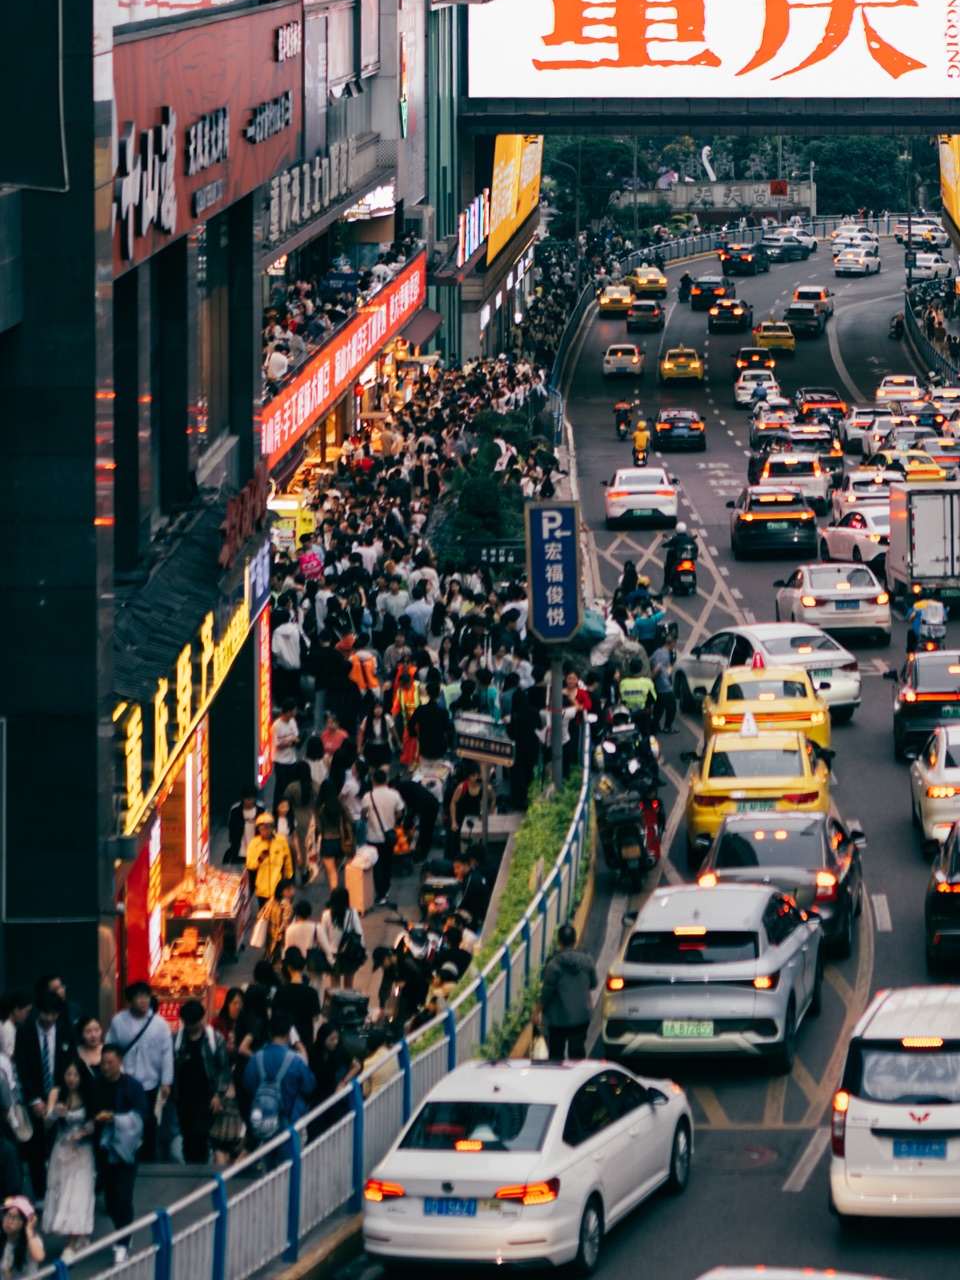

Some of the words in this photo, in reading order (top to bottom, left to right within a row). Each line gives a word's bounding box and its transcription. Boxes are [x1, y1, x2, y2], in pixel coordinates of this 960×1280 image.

[541, 510, 563, 540] P
[544, 542, 566, 627] 宏福俊悦
